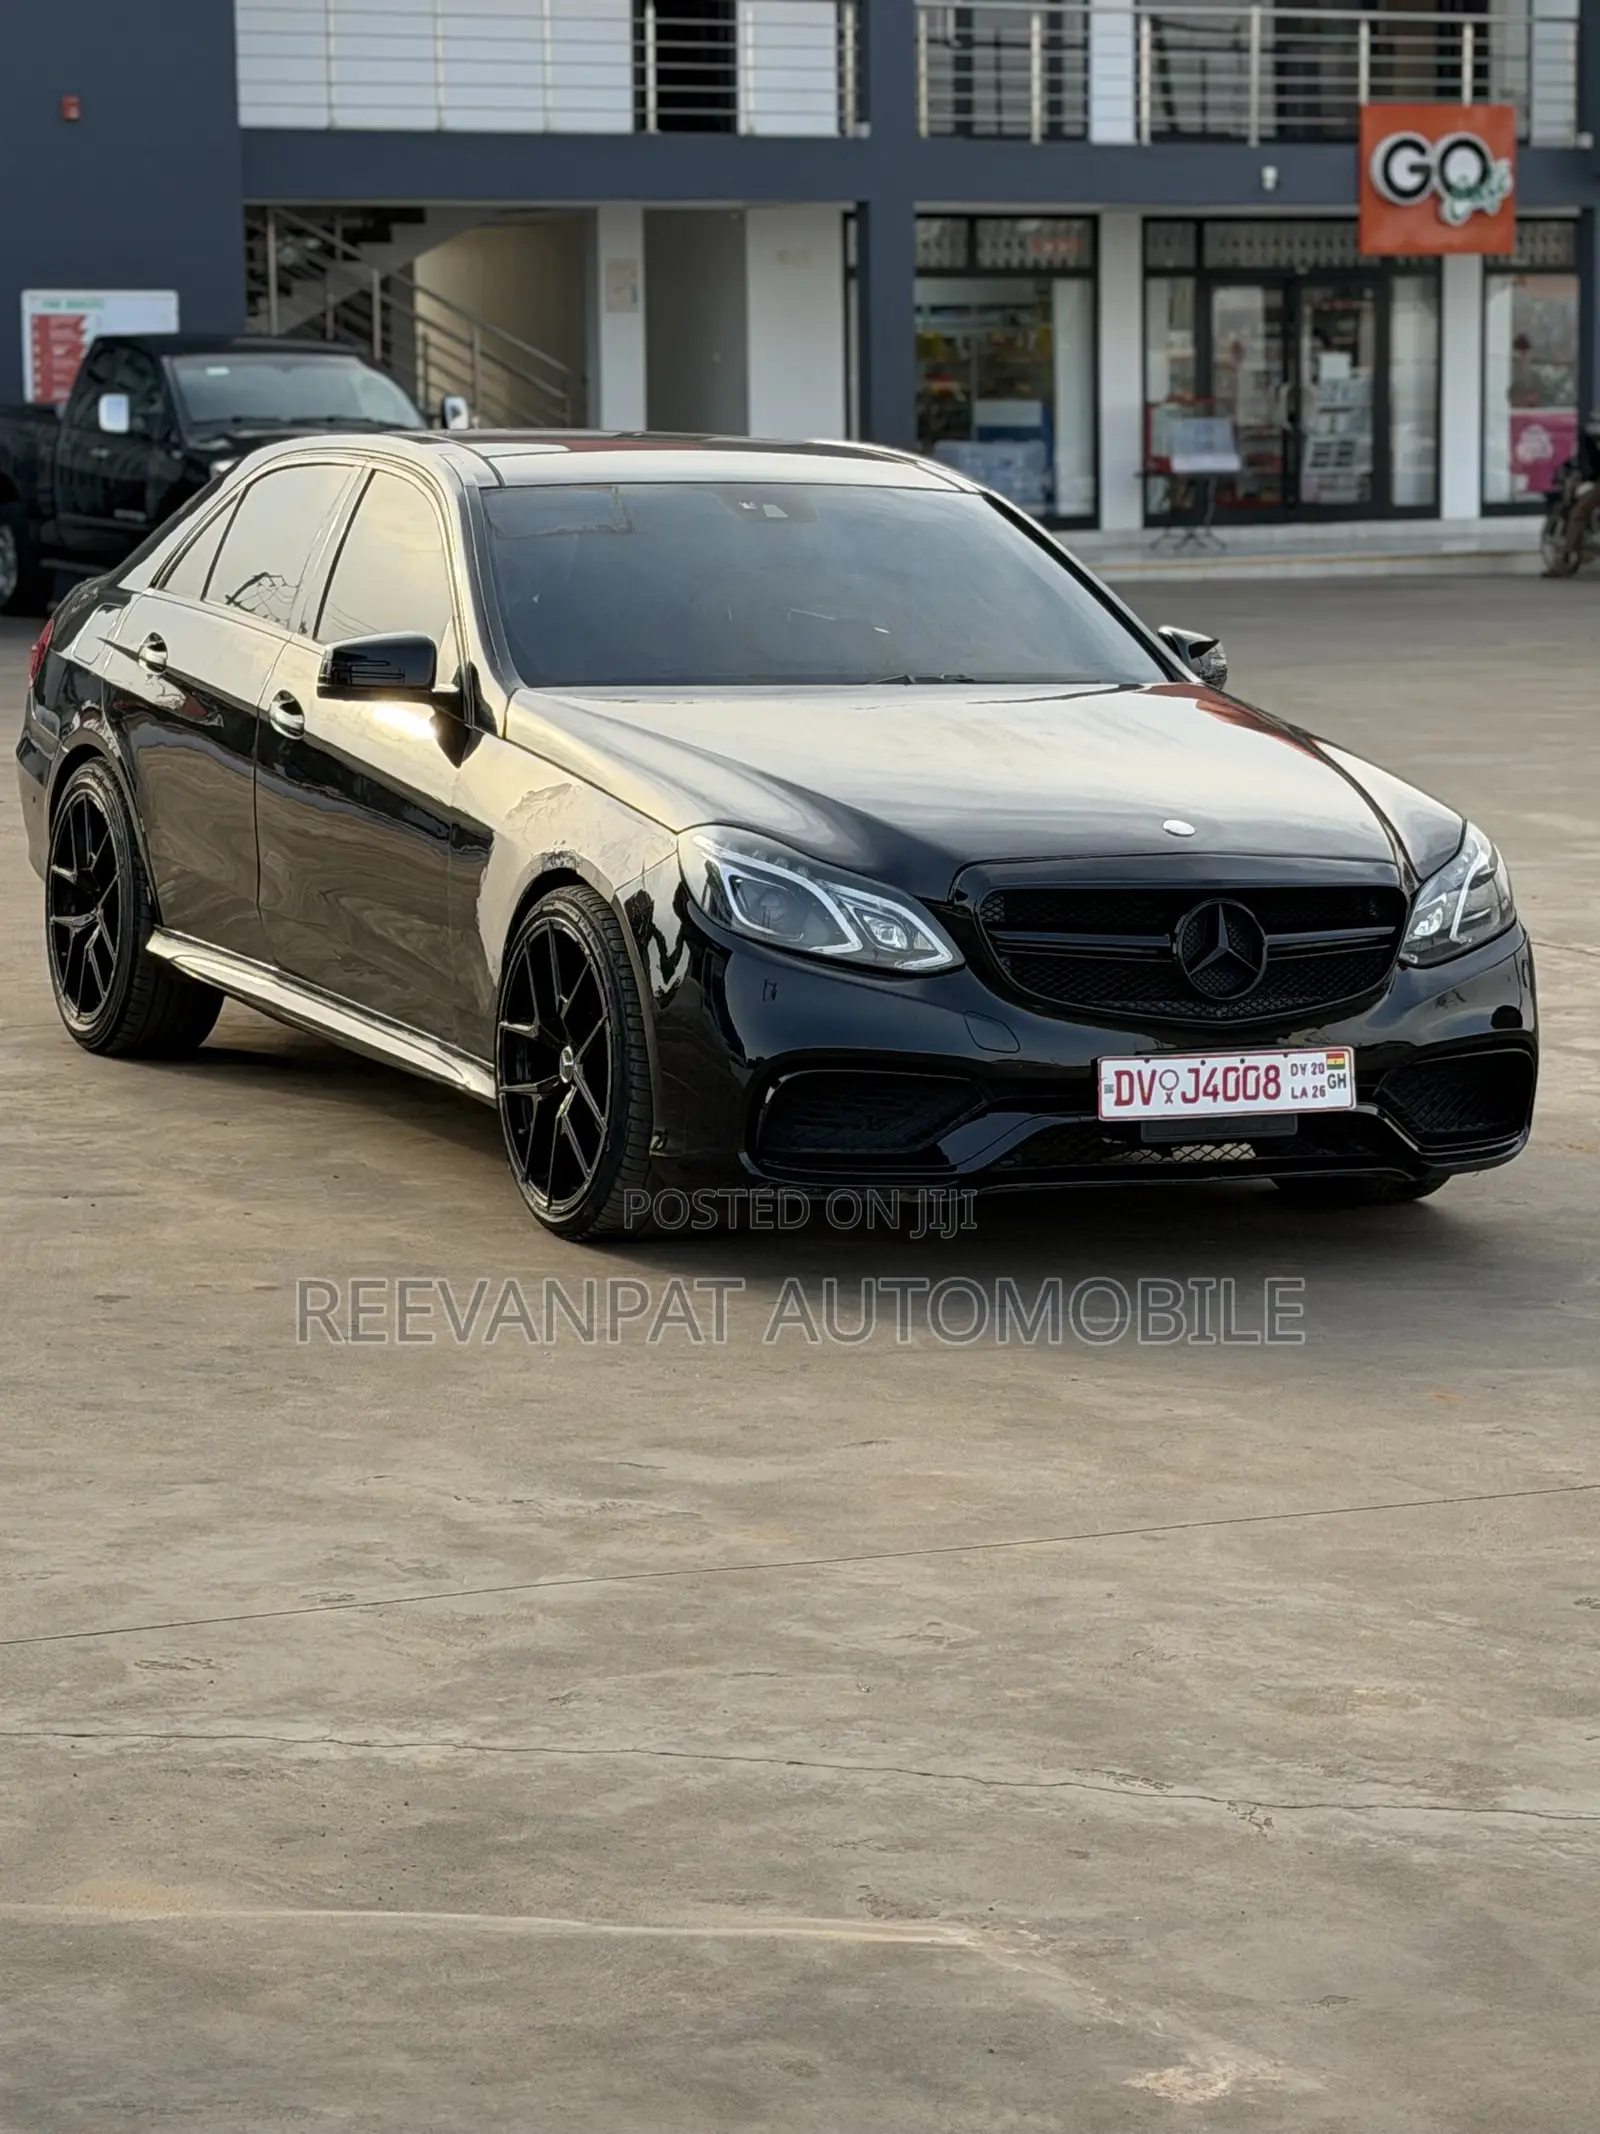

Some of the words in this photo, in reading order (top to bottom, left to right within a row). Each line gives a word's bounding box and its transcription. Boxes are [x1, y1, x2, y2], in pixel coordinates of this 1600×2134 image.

[1380, 136, 1490, 201] GO
[1311, 1062, 1325, 1076] 20
[1113, 1068, 1158, 1107] DV
[1180, 1064, 1282, 1104] J4008
[1327, 1073, 1347, 1090] GH
[1291, 1086, 1309, 1100] LA
[1312, 1085, 1326, 1099] 26
